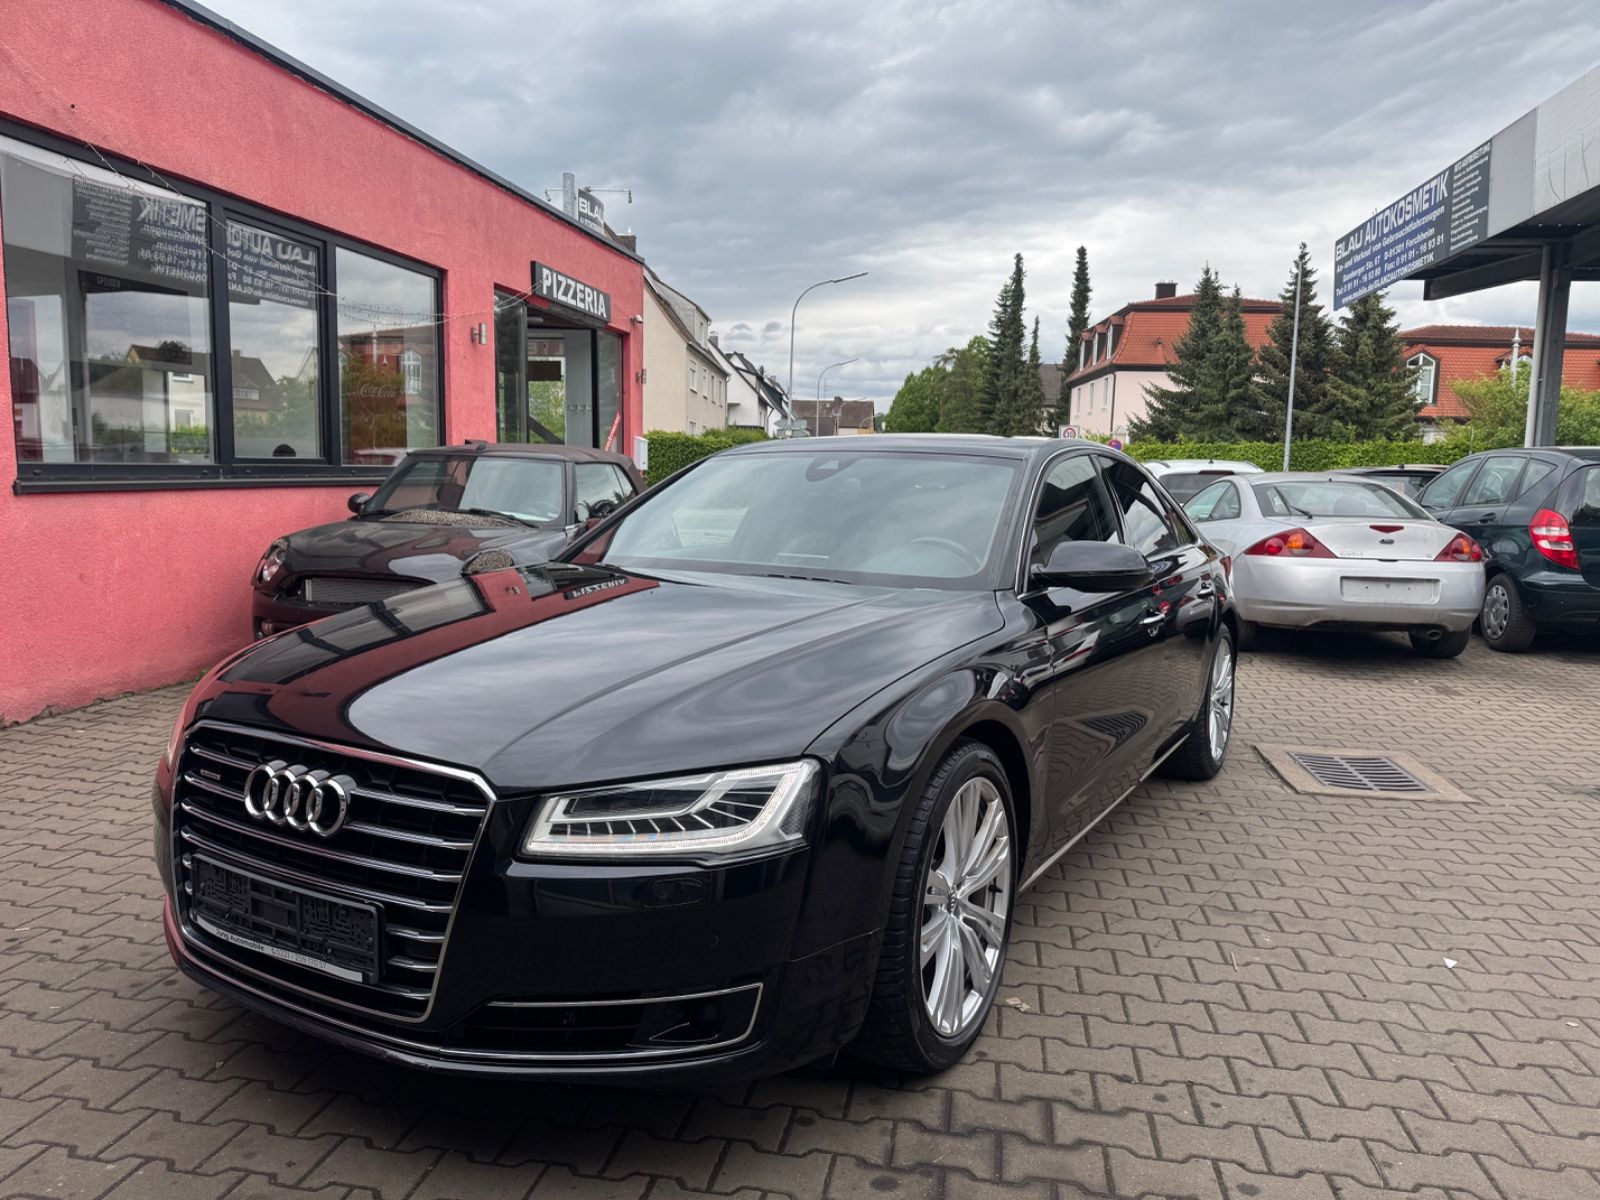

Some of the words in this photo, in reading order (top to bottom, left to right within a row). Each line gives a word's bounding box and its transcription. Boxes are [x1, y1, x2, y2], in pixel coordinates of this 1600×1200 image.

[1336, 229, 1363, 261] BLAU
[1364, 170, 1448, 246] AUTOKOSMETIK
[1406, 227, 1435, 249] Forchheim
[1354, 248, 1371, 263] Verkauf
[1372, 242, 1381, 252] von
[1400, 252, 1407, 263] 91
[1408, 249, 1415, 260] 91
[1428, 238, 1436, 249] 93
[542, 267, 607, 318] PIZZERIA
[230, 934, 264, 951] Automobile
